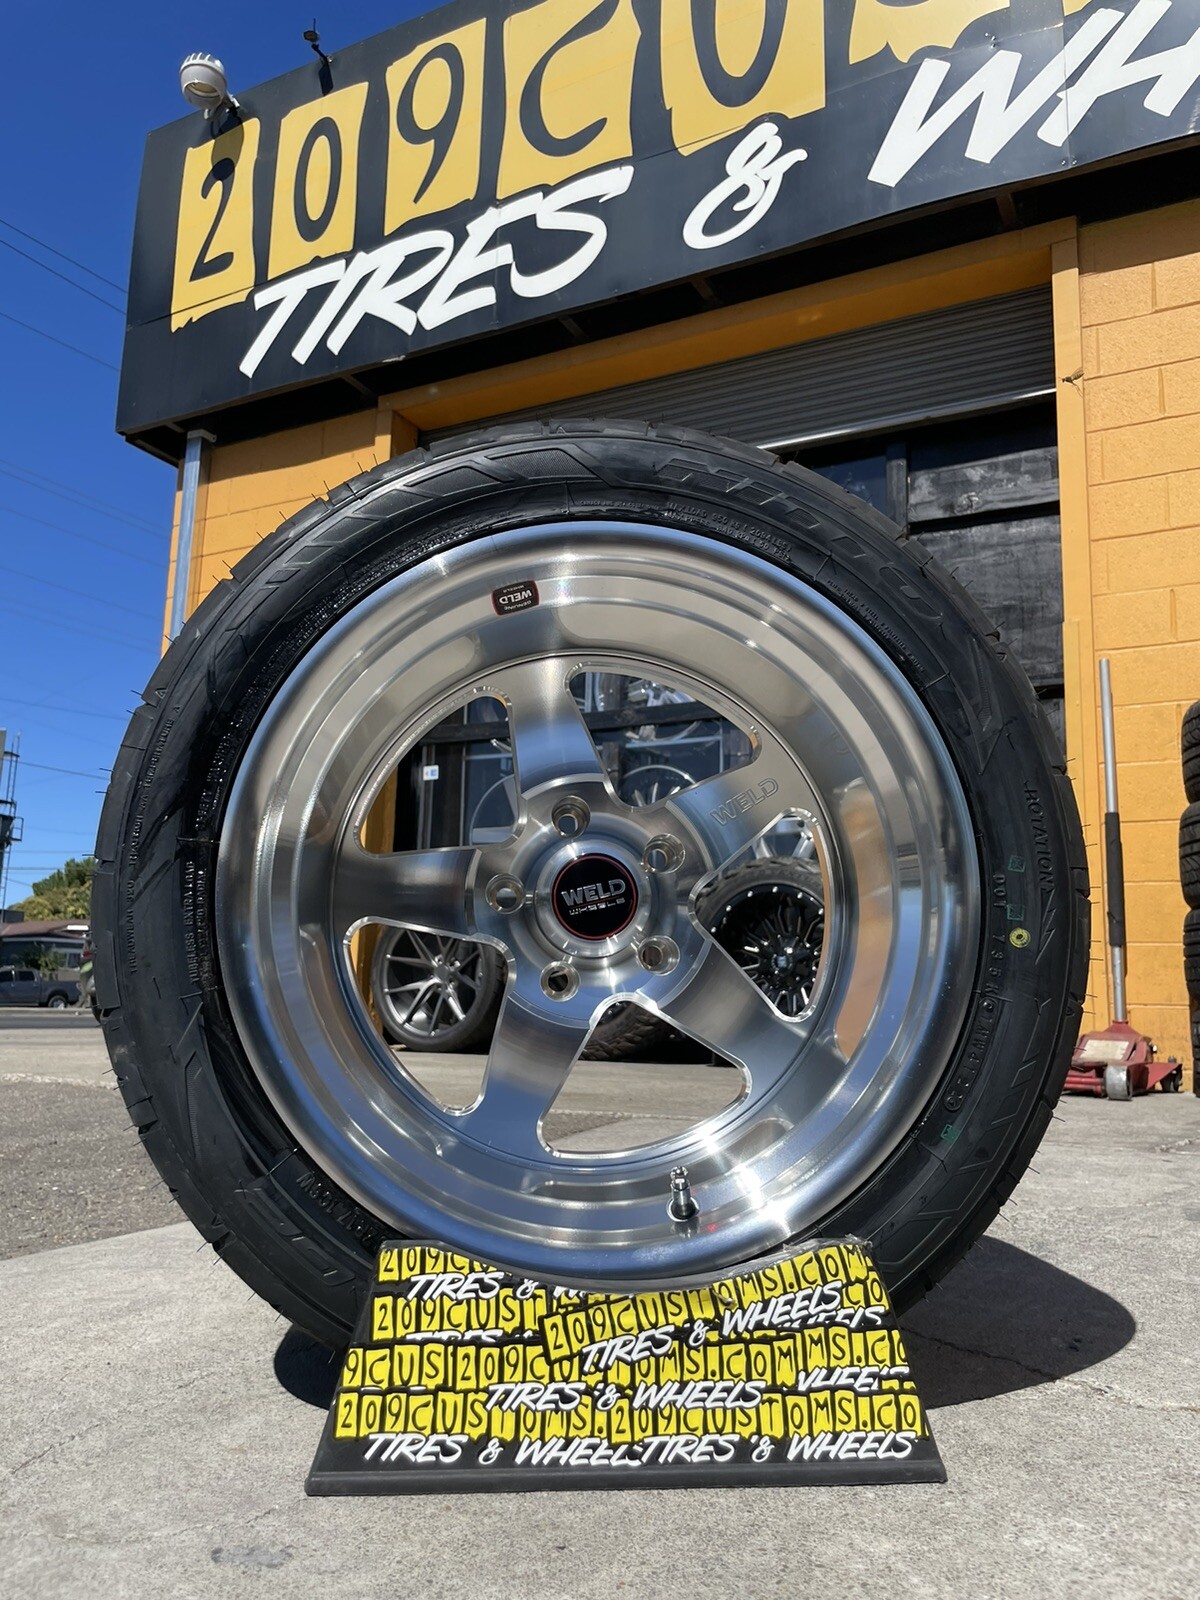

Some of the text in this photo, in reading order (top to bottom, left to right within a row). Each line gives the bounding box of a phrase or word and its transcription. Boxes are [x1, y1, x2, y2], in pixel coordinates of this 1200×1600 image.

[187, 0, 950, 284] 209CU
[239, 165, 634, 378] TIRES
[682, 122, 807, 249] &
[499, 589, 532, 604] WELD
[503, 599, 532, 611] GENUINE
[709, 777, 779, 827] WELD
[1025, 787, 1056, 892] ROTATION
[561, 878, 626, 907] WELD
[407, 1271, 505, 1301] TIRES
[582, 1280, 843, 1374] TIRES & WHEELS
[486, 1379, 768, 1412] TIRES & WHEELS
[364, 1432, 469, 1464] TIRES
[478, 1436, 504, 1465] &
[641, 1433, 741, 1464] TIRES
[751, 1435, 776, 1464] &
[786, 1430, 918, 1462] WHEELS
